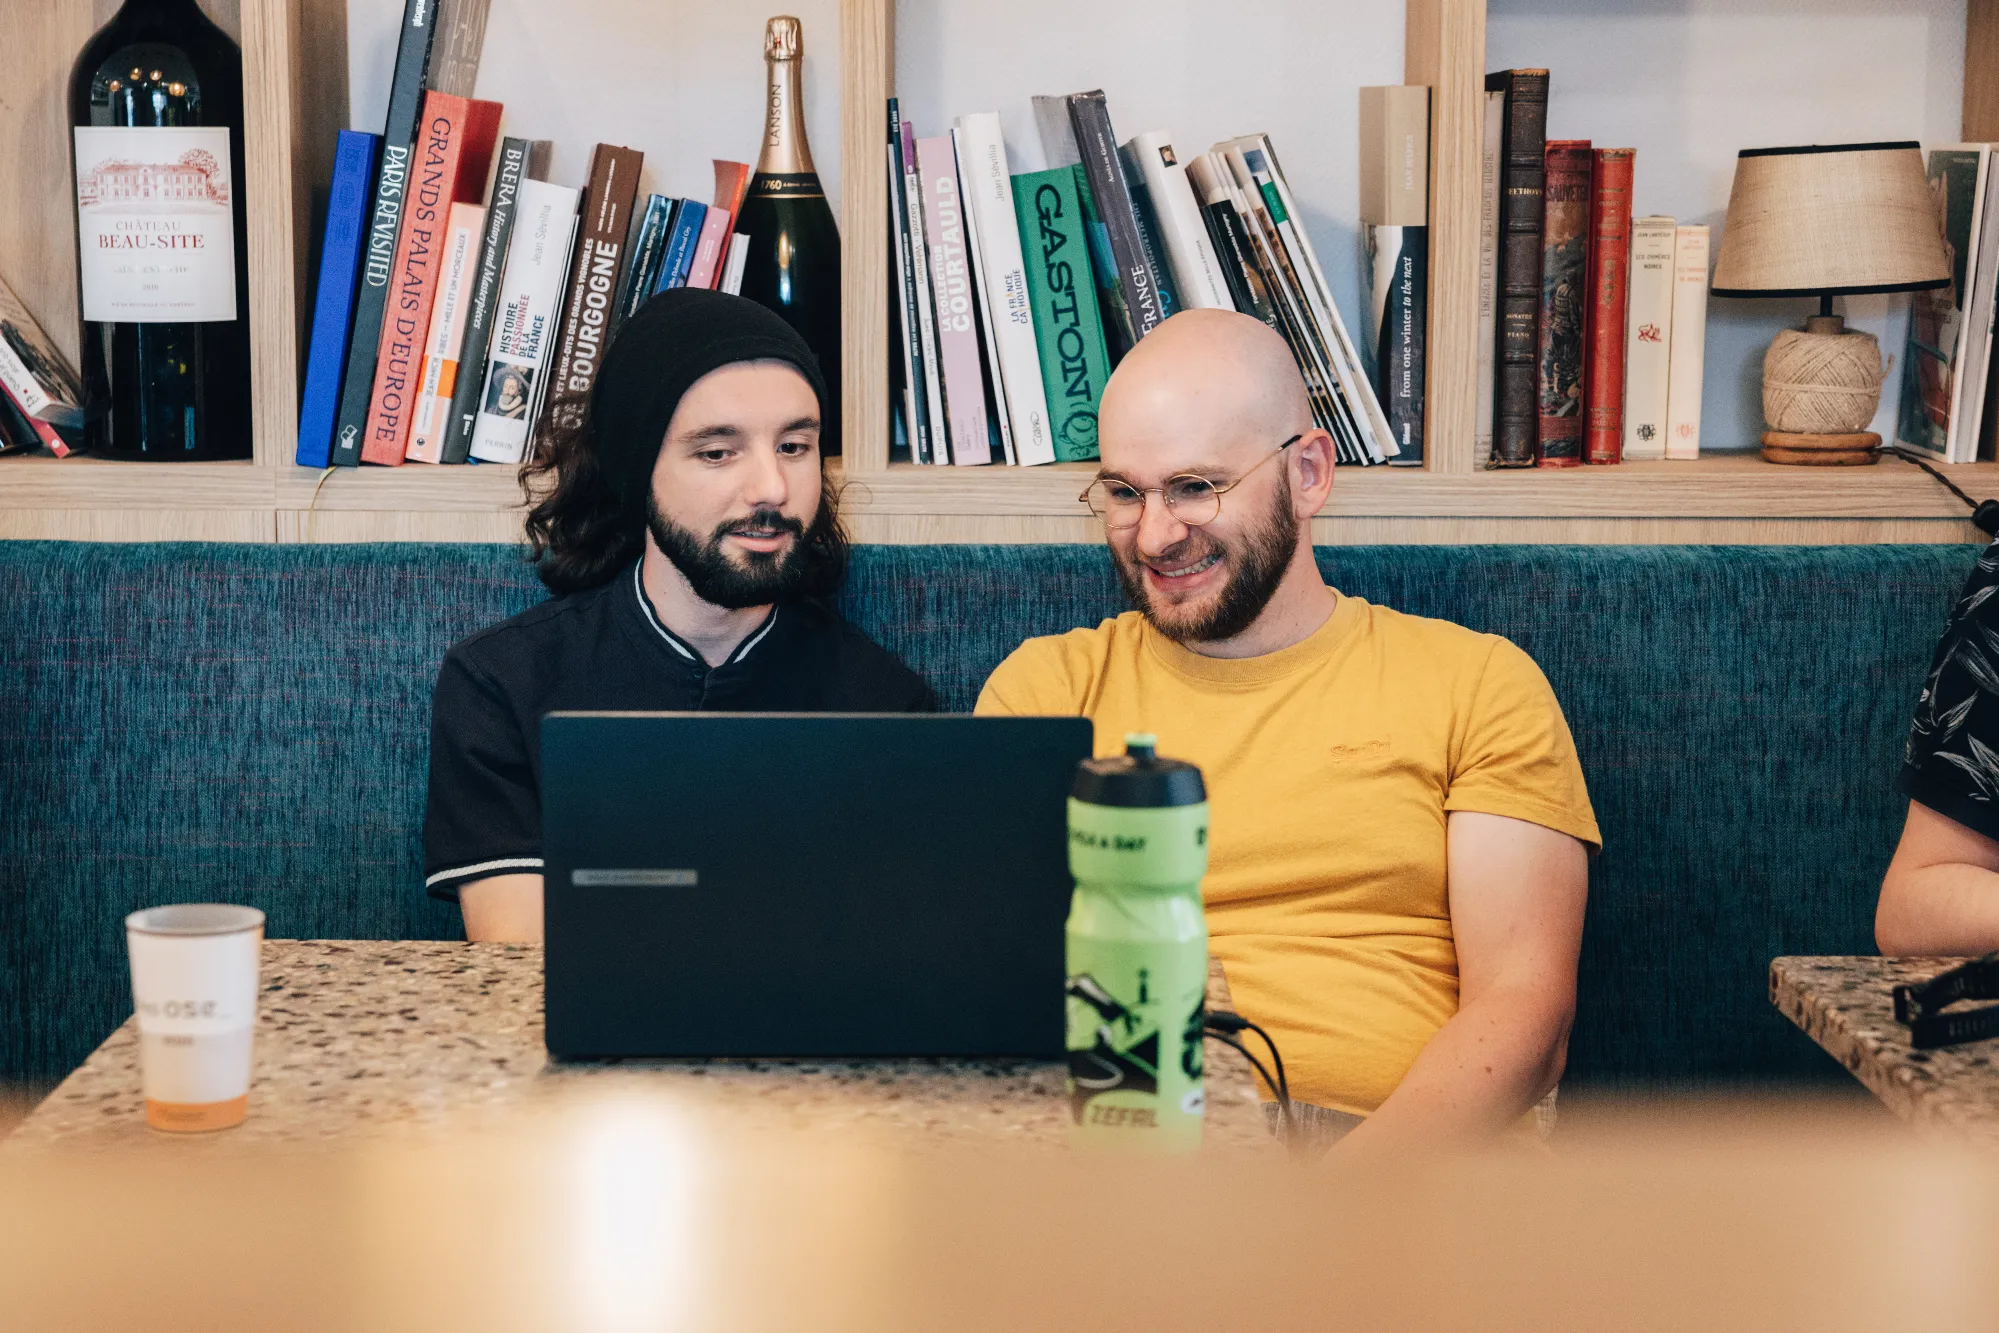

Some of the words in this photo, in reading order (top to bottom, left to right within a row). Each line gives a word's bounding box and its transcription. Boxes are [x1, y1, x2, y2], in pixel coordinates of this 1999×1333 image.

[769, 84, 782, 146] LANSON
[379, 145, 407, 198] PARIS
[414, 116, 452, 221] GRANDS
[496, 147, 522, 208] BRERA
[992, 179, 1005, 202] Jean
[116, 220, 181, 231] CHÂTEAU
[485, 207, 506, 246] History
[910, 203, 922, 236] Gazzotti
[99, 234, 204, 249] BEAU-SITE
[365, 198, 399, 287] REVISITED
[450, 234, 467, 278] MORCEAUX
[484, 246, 499, 268] and
[530, 241, 543, 265] Jean
[578, 237, 593, 283] VIGNOBLES
[937, 176, 971, 332] COURTAULD
[1137, 220, 1162, 286] METROPOLITAN
[398, 227, 432, 311] PALAIS
[915, 244, 926, 284] Vehlmann
[934, 244, 949, 314] COLLECTION
[1403, 256, 1411, 278] next
[446, 289, 456, 301] ET
[448, 278, 458, 289] UN
[469, 267, 494, 329] Masterpieces
[571, 283, 584, 317] GRANDS
[1004, 273, 1018, 309] FRANCE
[1035, 183, 1092, 401] GASTON
[1131, 264, 1159, 335] FRANCE
[1401, 281, 1411, 294] the
[1403, 296, 1411, 306] to
[442, 301, 454, 323] MILLE
[499, 301, 517, 353] HISTOIRE
[568, 319, 577, 335] DES
[569, 240, 618, 393] BOURGOGNE
[941, 317, 951, 331] LA
[1010, 311, 1019, 322] LA
[1401, 308, 1410, 343] winter
[518, 345, 527, 357] DE
[522, 333, 529, 343] LA
[523, 314, 547, 359] FRANCE
[559, 335, 574, 380] LIEUX-DITS
[373, 316, 417, 442] D'EUROPE
[1400, 370, 1410, 397] from
